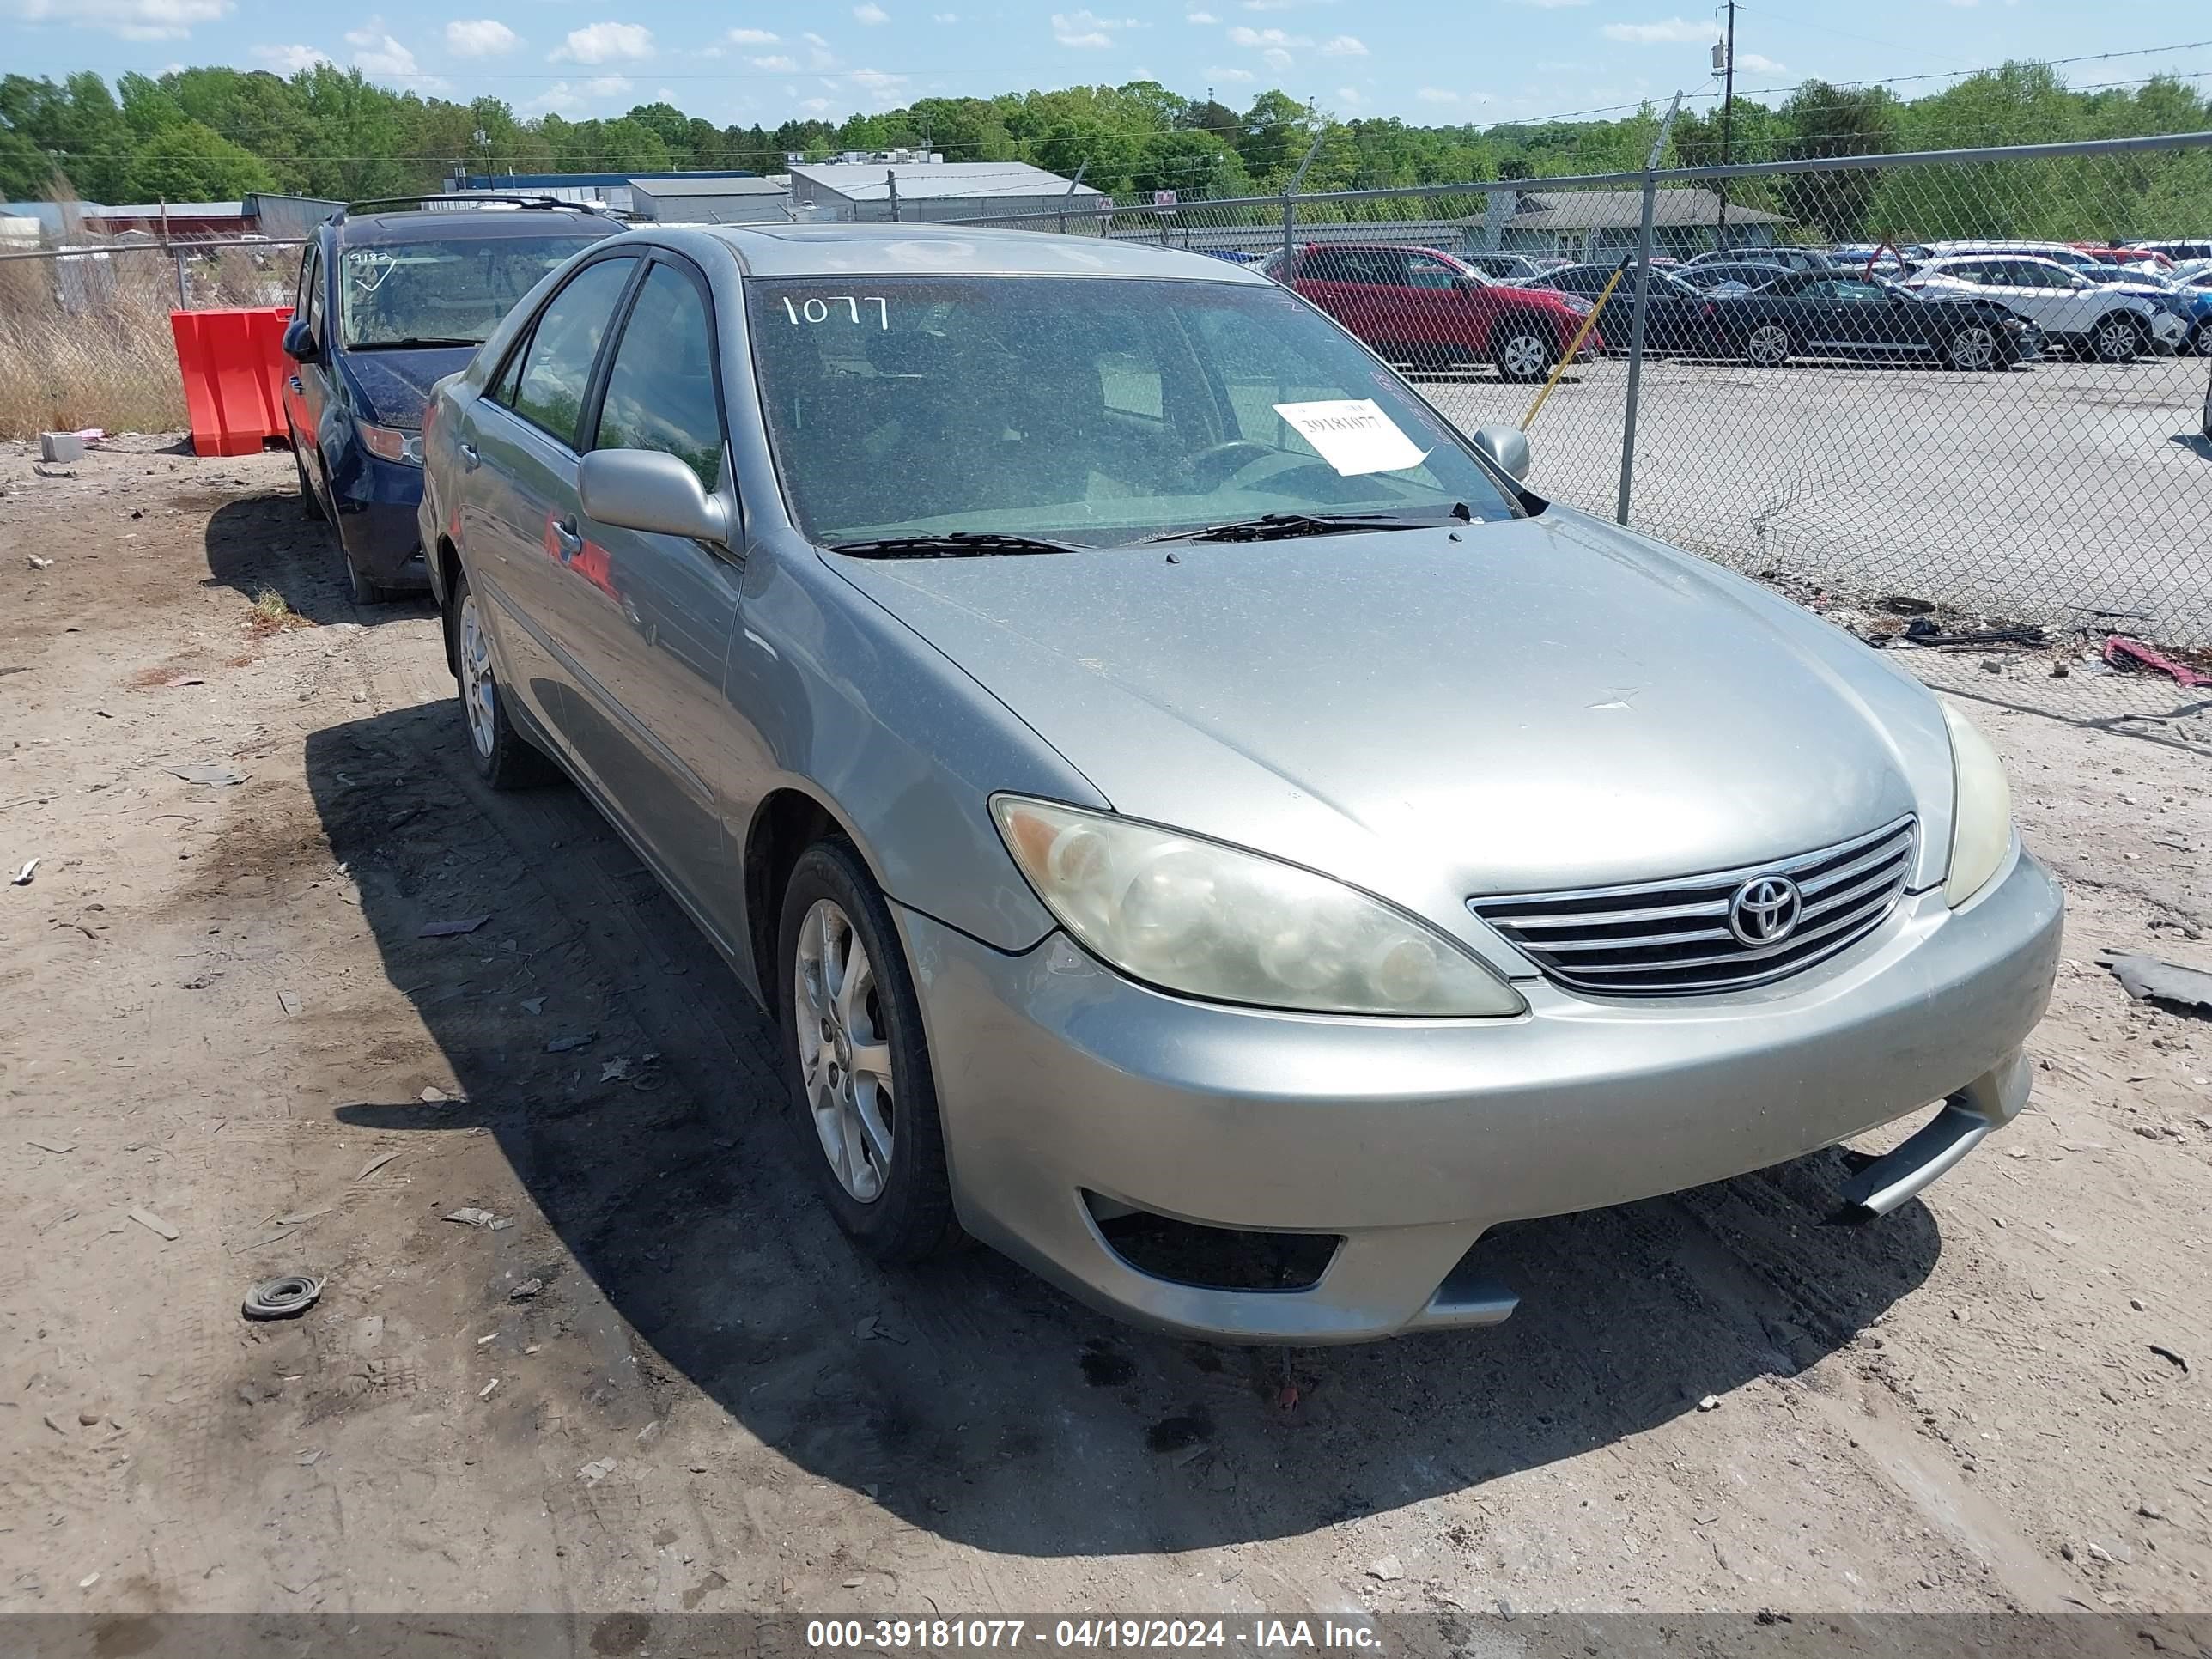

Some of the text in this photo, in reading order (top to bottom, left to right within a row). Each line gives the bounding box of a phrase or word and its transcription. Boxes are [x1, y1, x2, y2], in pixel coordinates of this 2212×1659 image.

[350, 252, 392, 264] 9182
[783, 296, 889, 331] 1077
[1301, 416, 1382, 433] 39181077
